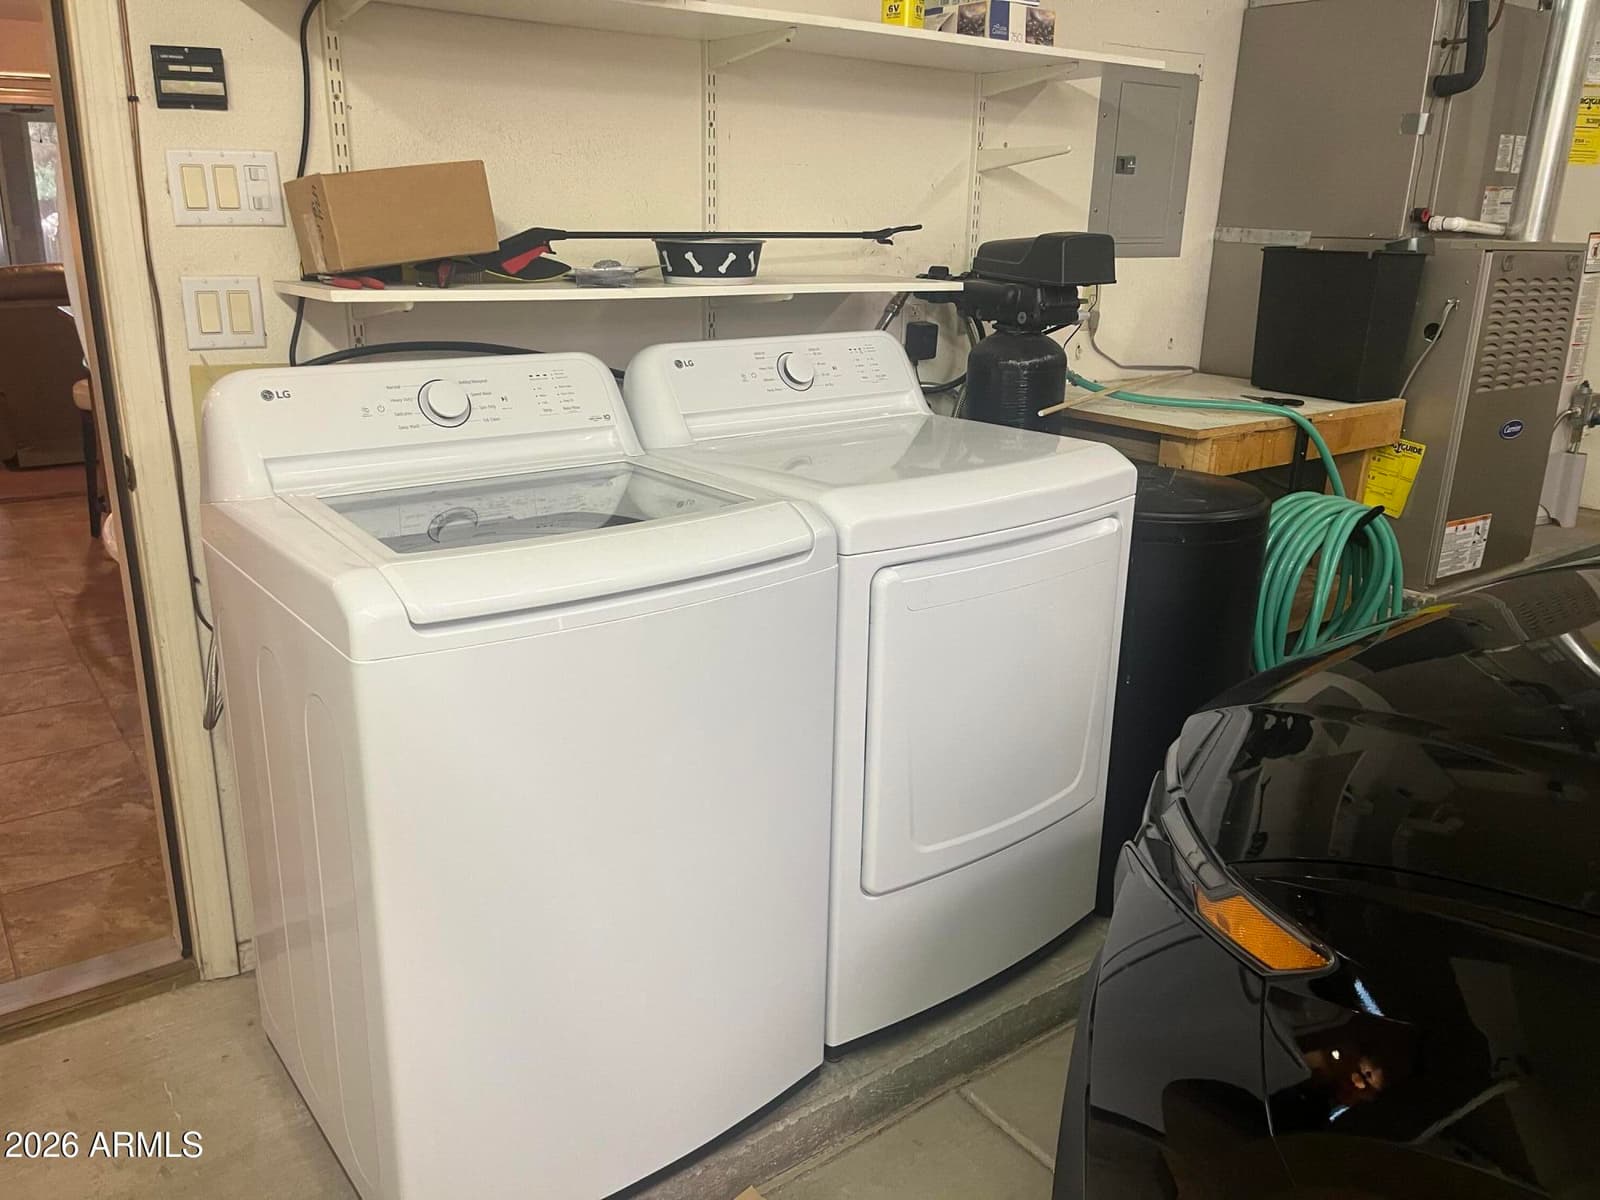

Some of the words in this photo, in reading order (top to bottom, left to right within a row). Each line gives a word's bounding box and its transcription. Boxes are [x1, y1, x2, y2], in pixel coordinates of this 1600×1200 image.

[888, 4, 900, 13] 6V
[683, 359, 695, 368] LG
[275, 390, 291, 399] LG
